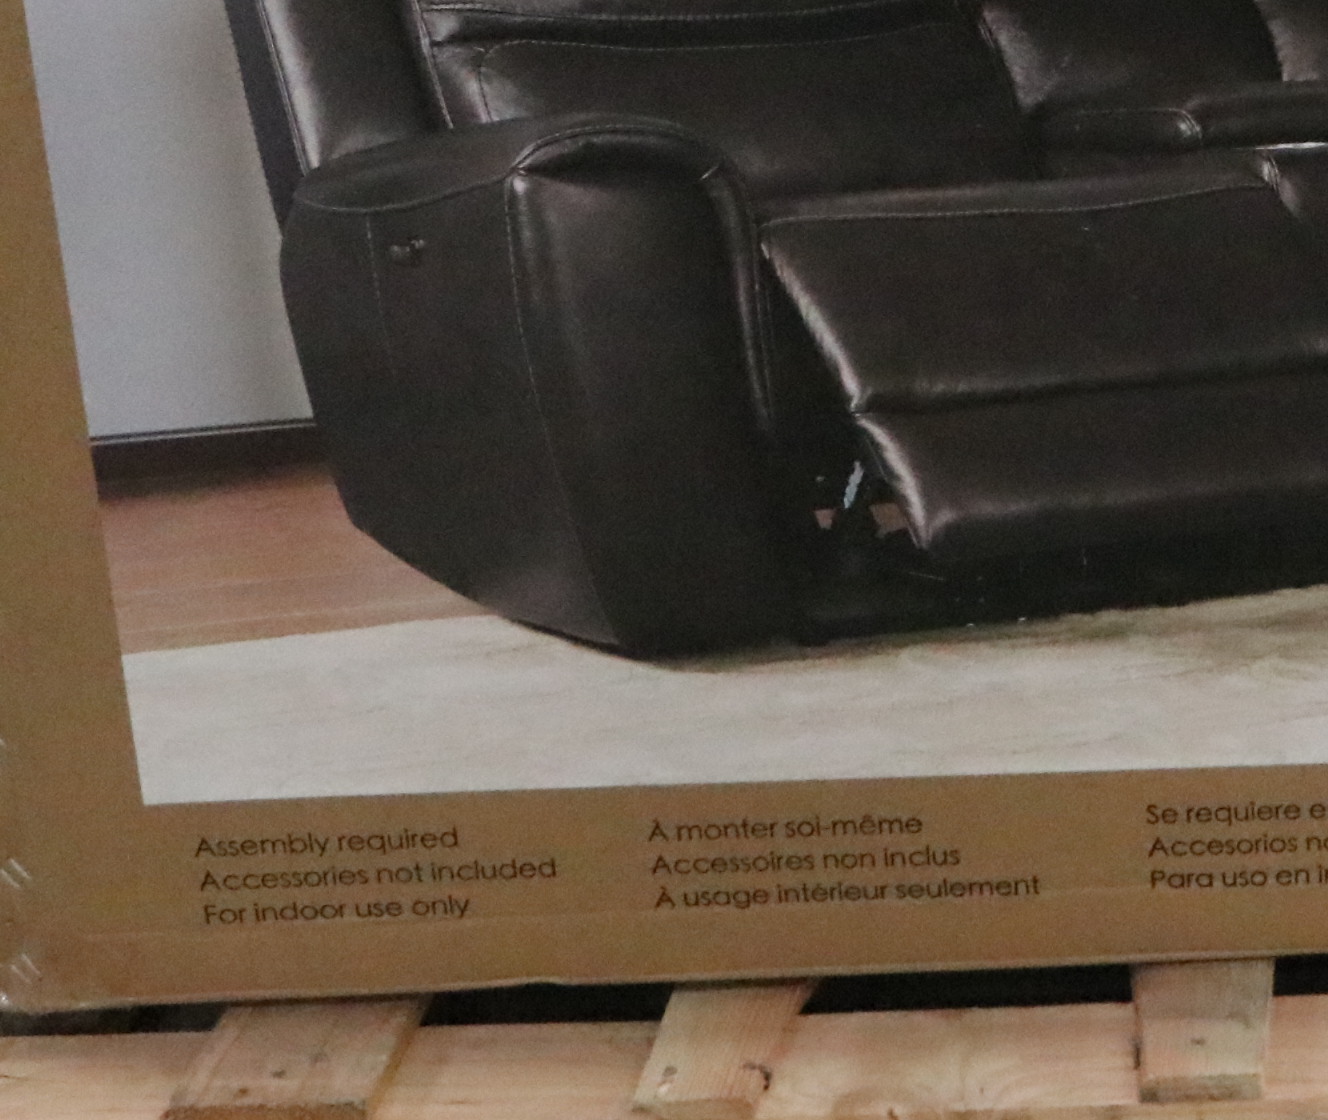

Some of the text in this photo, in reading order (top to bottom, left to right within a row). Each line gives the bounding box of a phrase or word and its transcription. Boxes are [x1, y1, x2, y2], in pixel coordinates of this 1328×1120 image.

[676, 818, 778, 841] monter
[785, 814, 923, 838] soi-même
[1146, 804, 1179, 825] Se
[1186, 801, 1301, 827] requiere
[194, 826, 459, 858] Assembly required
[1148, 833, 1298, 858] Accesorios
[199, 857, 557, 892] Accessories not included
[650, 845, 961, 875] Accessoires non inclus
[682, 889, 770, 910] usage
[777, 881, 888, 903] intérieur
[895, 875, 1039, 899] seulement
[1149, 869, 1215, 889] Para
[1221, 869, 1268, 888] uso
[1275, 868, 1311, 886] en
[203, 895, 470, 925] For indoor use only
